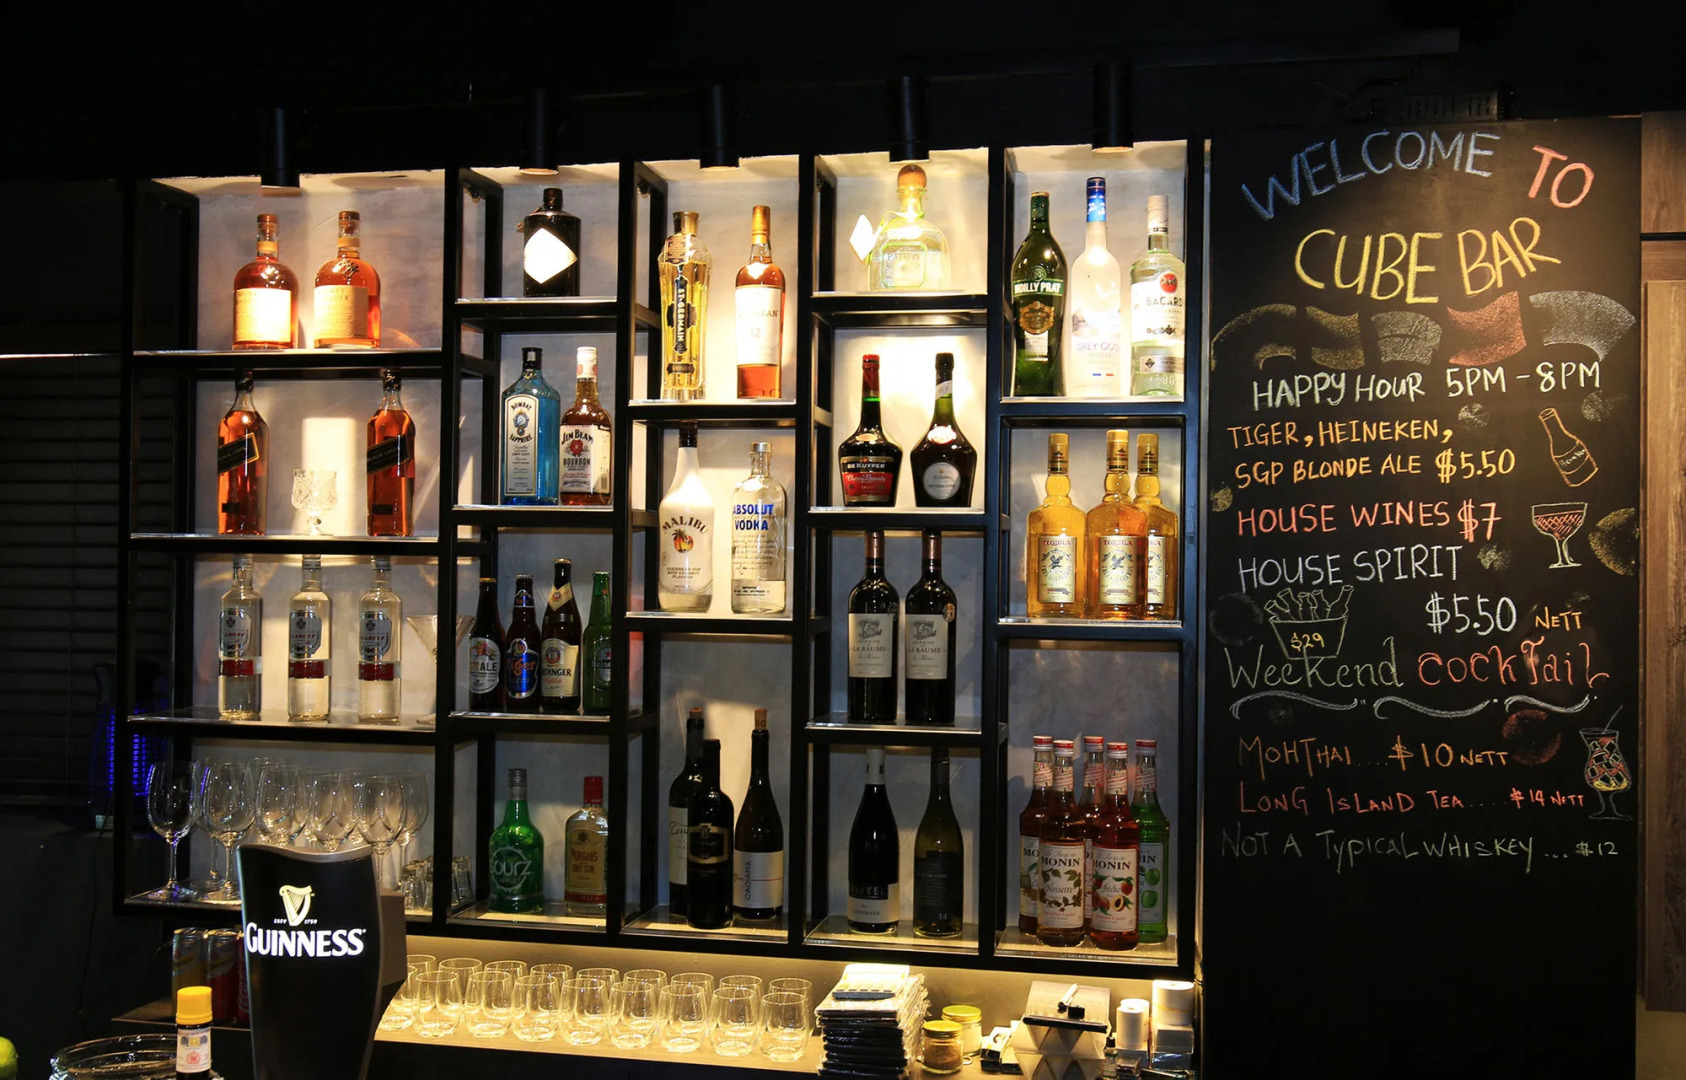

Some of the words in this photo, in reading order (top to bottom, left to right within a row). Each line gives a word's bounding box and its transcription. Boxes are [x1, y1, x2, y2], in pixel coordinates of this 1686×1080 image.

[1242, 128, 1500, 221] WELCOME
[1528, 145, 1595, 209] TO
[1294, 229, 1443, 304] CUBE
[1457, 217, 1561, 296] BAR
[1041, 280, 1062, 294] PRAT
[1252, 371, 1346, 411] HAPPY
[1355, 371, 1426, 402] HOUR
[1446, 365, 1507, 398] 5PM
[1539, 360, 1601, 393] 8PM
[510, 401, 533, 411] BOMBAY
[509, 434, 533, 444] SAPPHIRE
[561, 431, 574, 445] JIM
[1228, 420, 1313, 449] TIGER,
[1318, 418, 1455, 447] HEINEKEN,
[563, 457, 591, 466] BOURBON
[1235, 460, 1284, 490] SGP
[1293, 454, 1373, 483] BLONDE
[1380, 453, 1422, 476] ALE
[1434, 448, 1516, 485] $5.50
[733, 503, 775, 516] ABSOLUT
[662, 515, 709, 536] MALIBU
[735, 519, 769, 531] VODKA
[1237, 502, 1338, 538] HOUSE
[1350, 501, 1451, 527] WINES
[1457, 498, 1502, 543] $7
[1238, 554, 1343, 593] HOUSE
[1353, 544, 1464, 583] SPIRIT
[1426, 591, 1517, 635] $5.50
[1535, 606, 1582, 631] NETT
[1290, 633, 1325, 651] $29
[480, 662, 498, 671] ALE
[506, 657, 535, 676] Tiger
[1460, 749, 1508, 765] NETT
[1240, 780, 1309, 816] LONG
[1327, 787, 1415, 816] ISLAND
[1426, 790, 1465, 810] TEA
[1550, 790, 1584, 807] NETT
[1222, 821, 1269, 857] NOT
[1283, 832, 1303, 858] A
[1422, 832, 1535, 875] WHISKEY
[1574, 840, 1619, 858] $12
[1041, 856, 1080, 867] MONIN
[246, 922, 364, 957] GUINNESS
